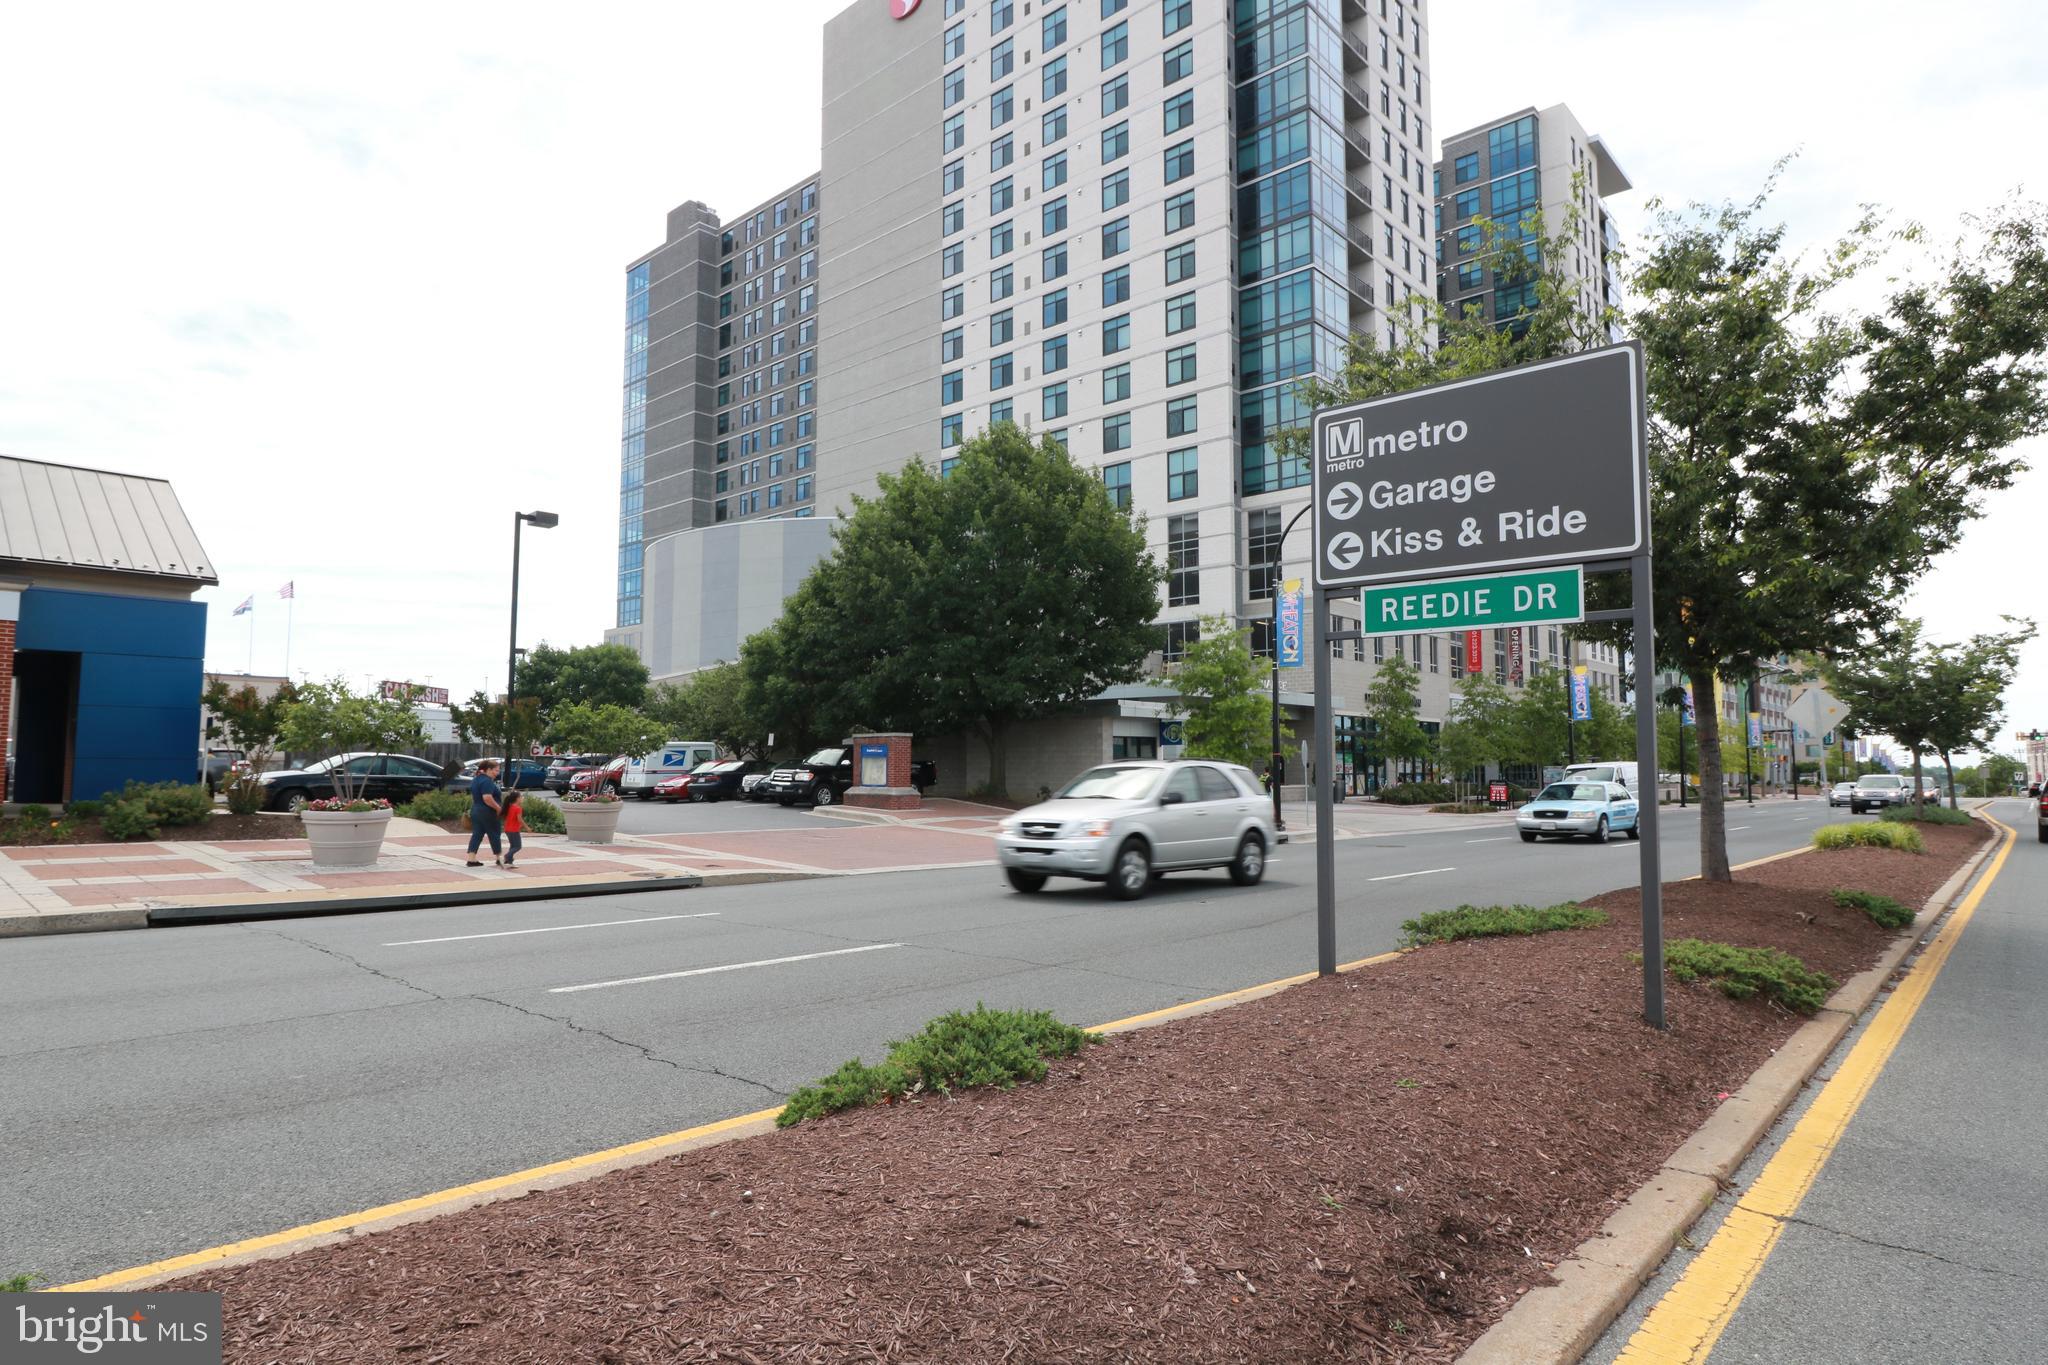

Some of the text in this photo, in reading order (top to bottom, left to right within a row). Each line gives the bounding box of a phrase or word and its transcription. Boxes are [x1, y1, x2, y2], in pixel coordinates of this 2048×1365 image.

[1329, 420, 1468, 458] M metro
[1326, 458, 1365, 473] metro
[1369, 470, 1496, 509] Garage
[1371, 505, 1587, 558] Kiss & Ride
[1382, 583, 1557, 622] REEDIE DR
[1282, 592, 1299, 663] WHEATON
[1511, 629, 1520, 667] OPENING
[411, 684, 439, 703] ASH
